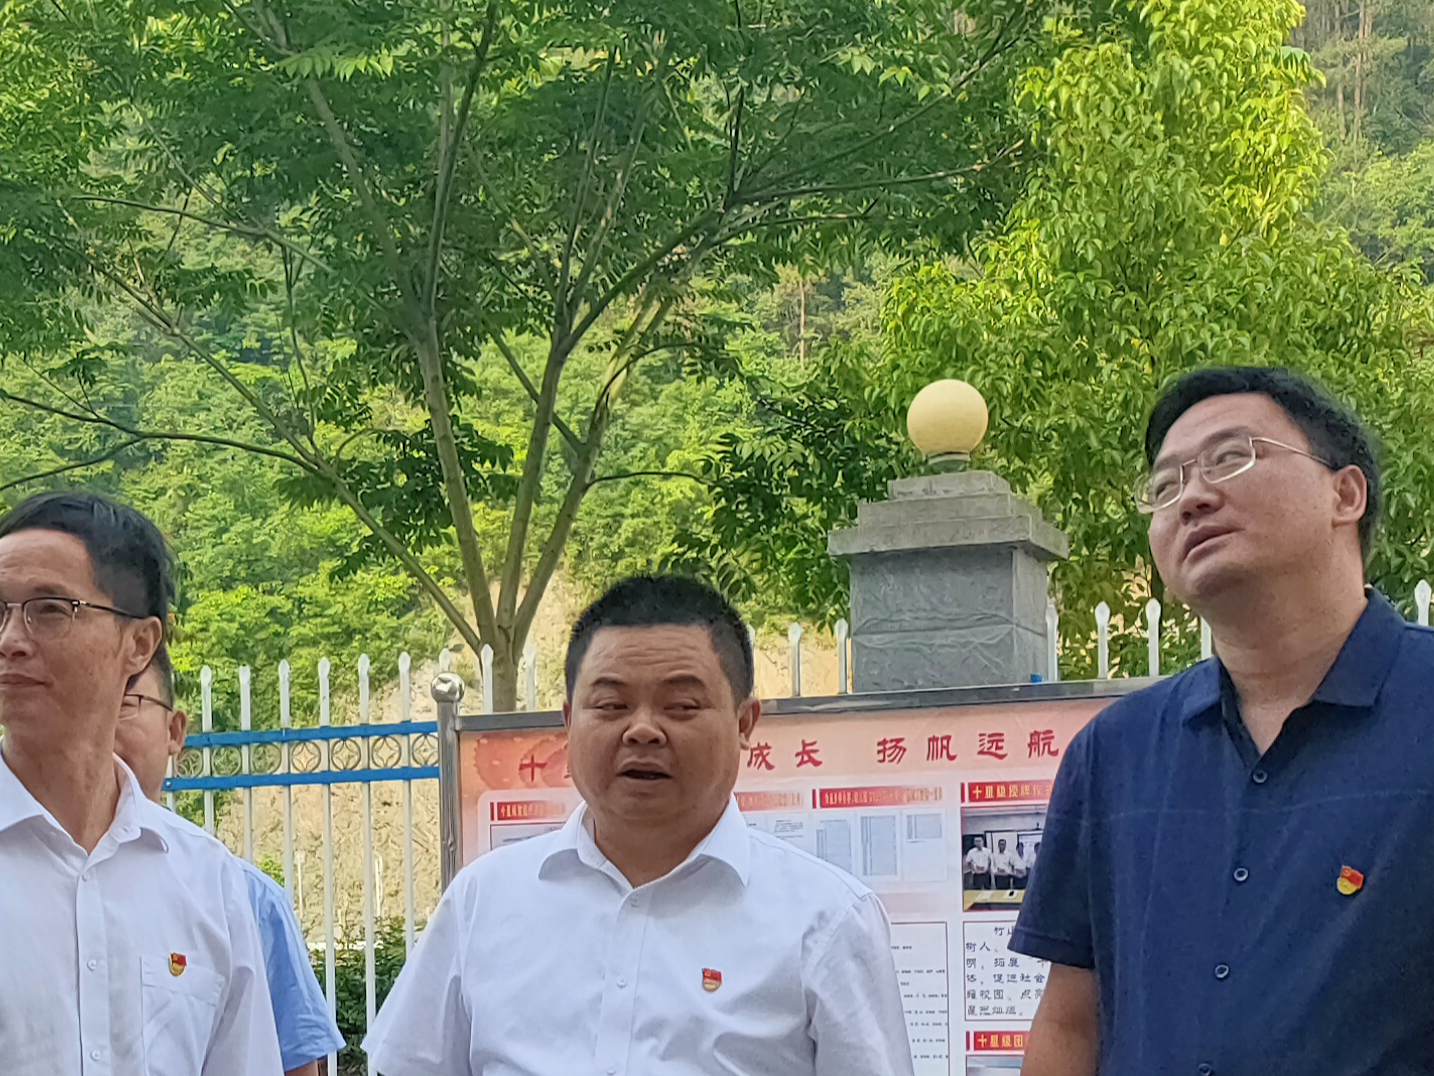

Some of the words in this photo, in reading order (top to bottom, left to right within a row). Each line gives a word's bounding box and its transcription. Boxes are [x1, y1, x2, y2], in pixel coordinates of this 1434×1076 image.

[747, 739, 823, 771] 成长
[877, 730, 1059, 764] 扬帆远航
